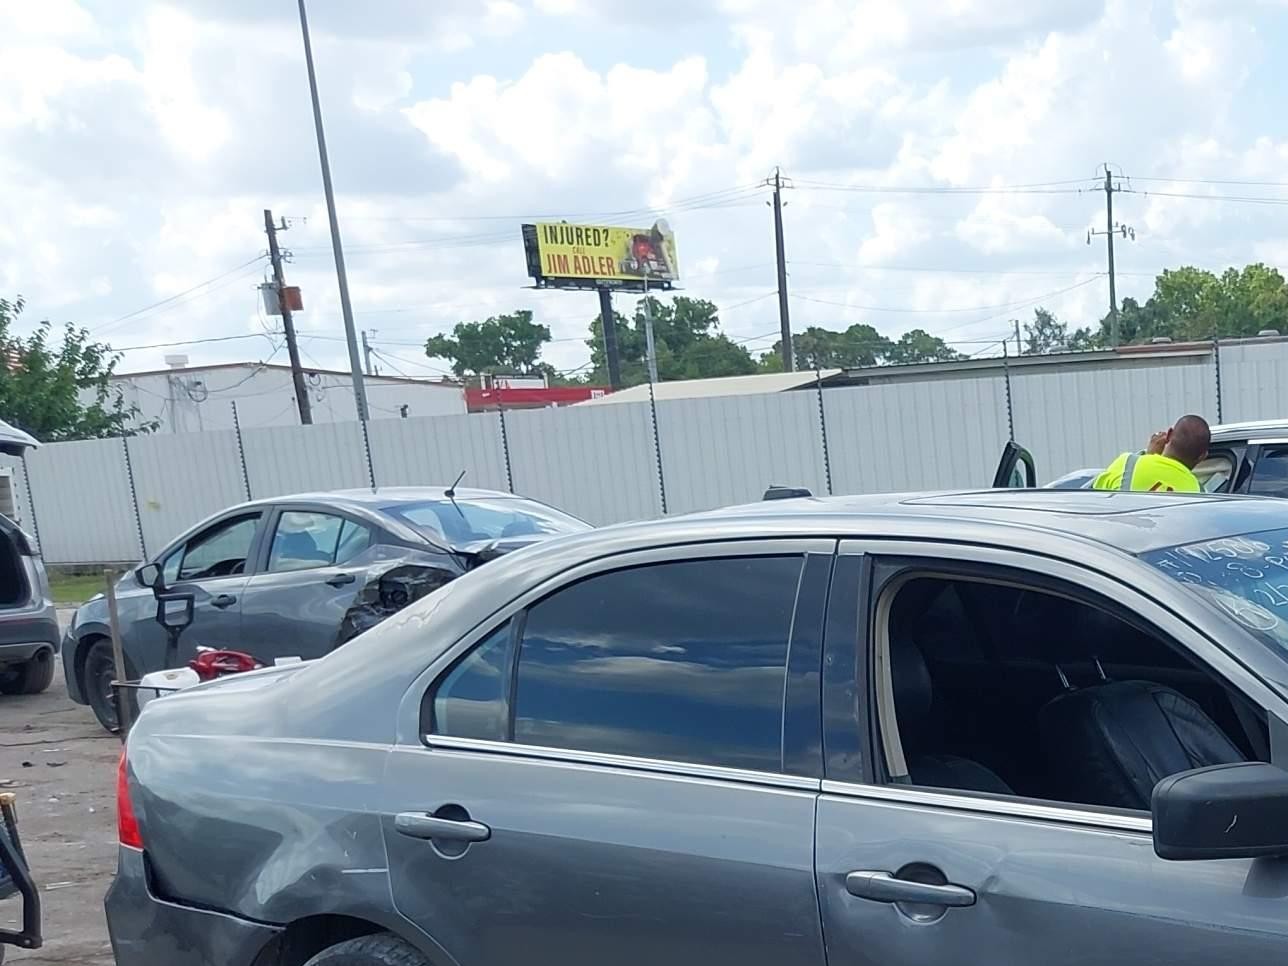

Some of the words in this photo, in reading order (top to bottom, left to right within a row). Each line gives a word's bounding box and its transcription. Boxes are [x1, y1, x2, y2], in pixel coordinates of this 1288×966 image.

[544, 225, 609, 247] INJURED?
[547, 254, 570, 274] JIM
[574, 256, 616, 276] ADLER
